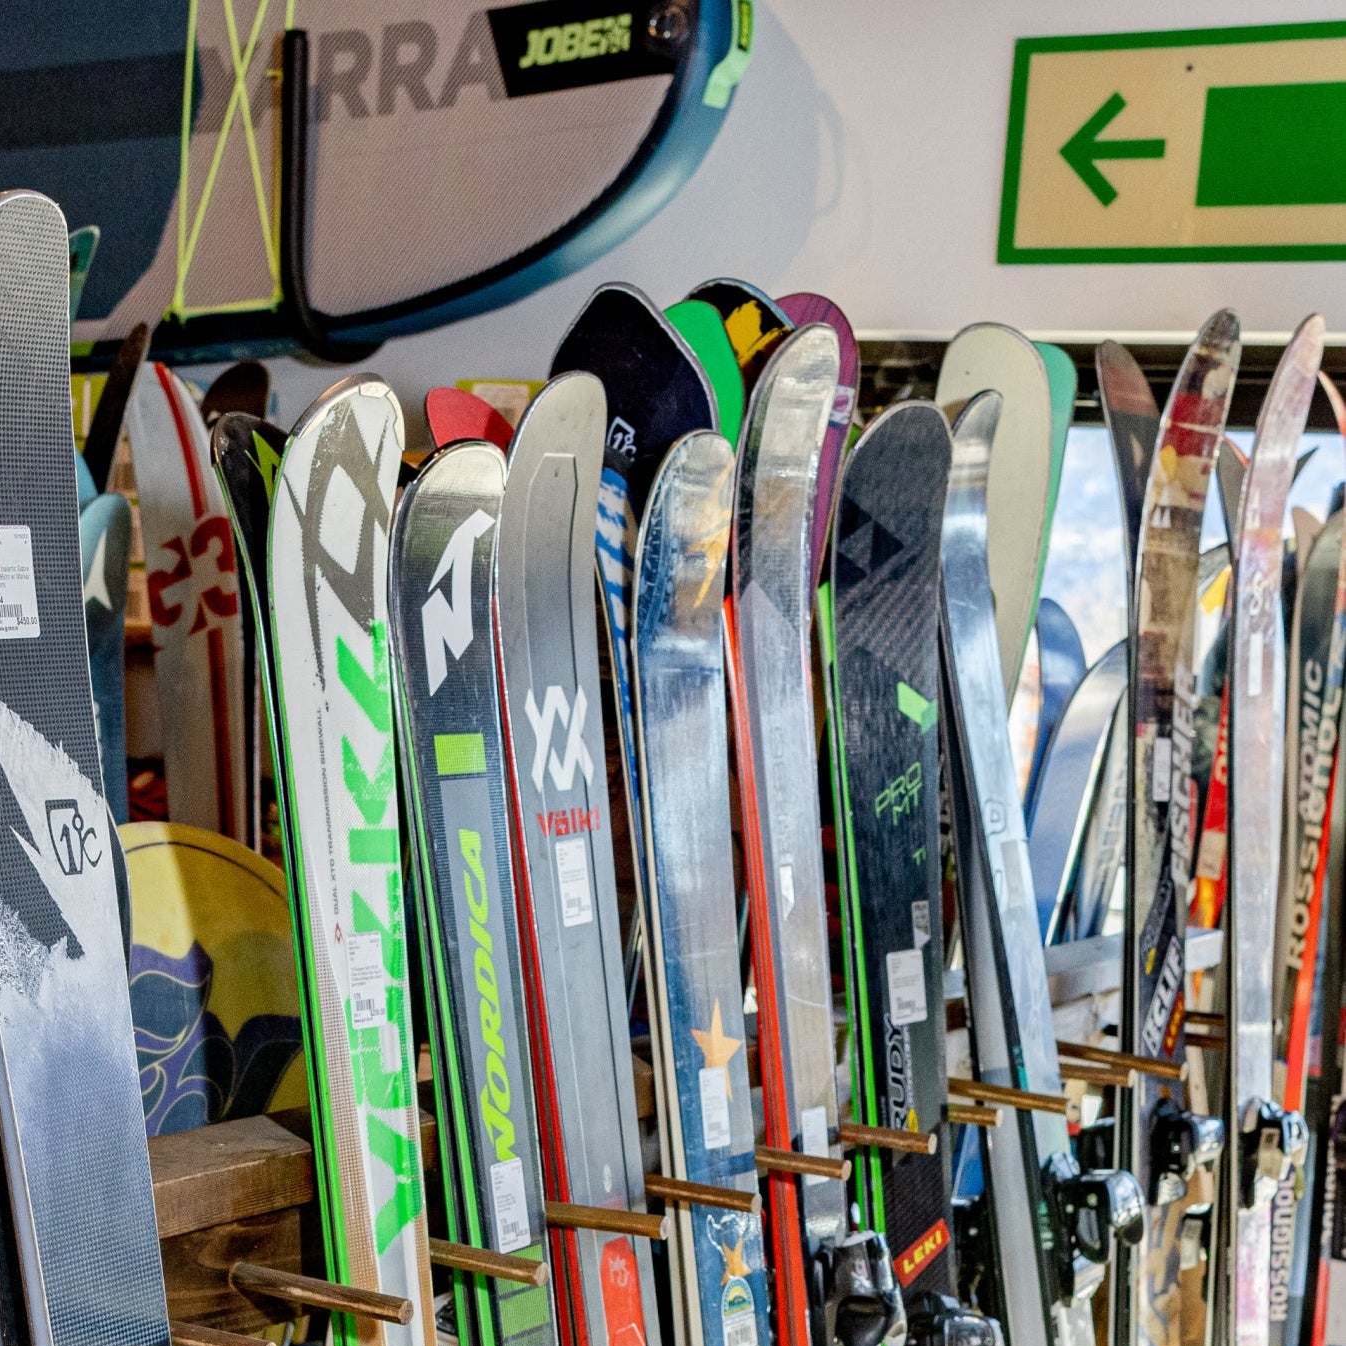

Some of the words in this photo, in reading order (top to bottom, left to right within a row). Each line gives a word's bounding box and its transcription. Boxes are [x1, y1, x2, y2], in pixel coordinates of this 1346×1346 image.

[519, 20, 608, 69] JOBE
[147, 515, 238, 635] G3
[316, 706, 326, 766] SIDEWALL
[874, 762, 922, 819] PRO
[893, 781, 923, 826] MT
[1170, 662, 1195, 888] FISCHER
[535, 809, 601, 837] Völkl
[459, 828, 518, 1161] NORDICA
[901, 1229, 943, 1275] LEKI
